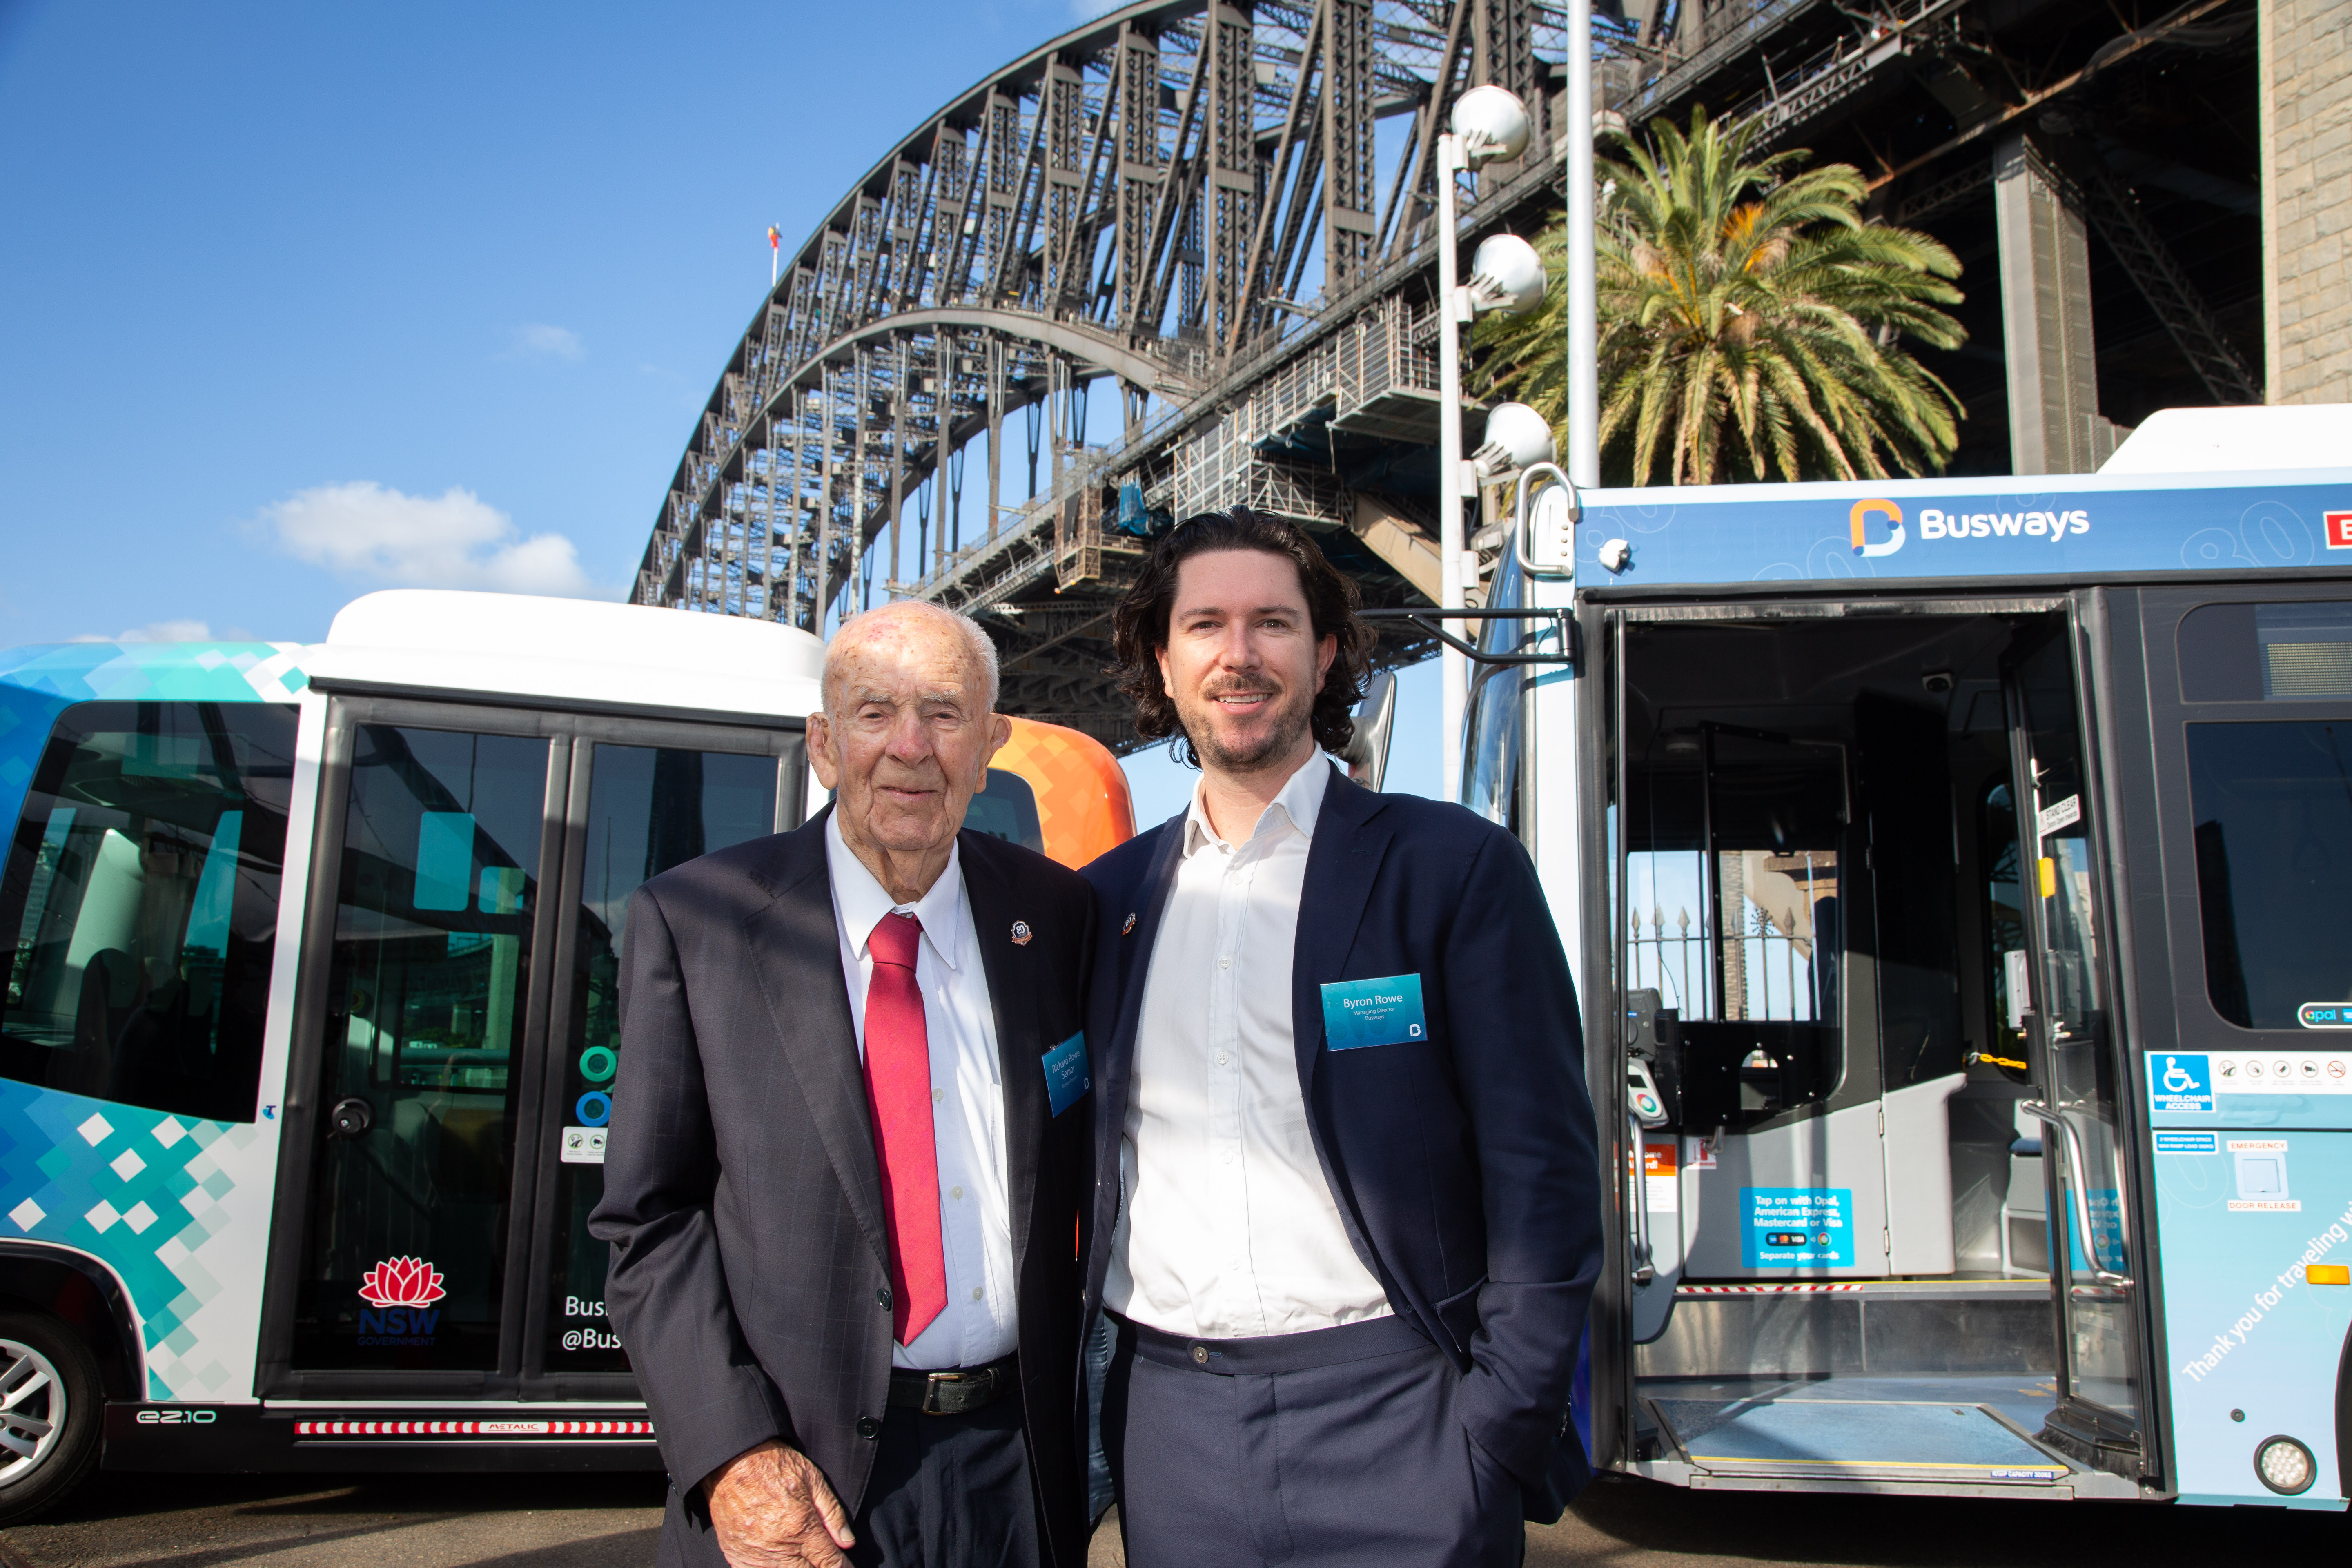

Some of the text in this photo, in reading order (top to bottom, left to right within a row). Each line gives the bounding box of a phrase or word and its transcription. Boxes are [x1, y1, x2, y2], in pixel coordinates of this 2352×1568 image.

[1920, 509, 2090, 543] Busways
[2046, 797, 2076, 820] STAND CLEAR
[1016, 925, 1025, 934] 80
[1343, 994, 1403, 1010] Byron Rowe
[1052, 1050, 1080, 1074] Richard Rowe
[1061, 1065, 1075, 1079] Senior
[1755, 1196, 1773, 1207] Tap
[1790, 1195, 1812, 1205] with
[1814, 1195, 1840, 1207] Opal,
[1754, 1207, 1840, 1218] American Express,
[1754, 1217, 1808, 1227] Mastercard
[1822, 1217, 1843, 1227] Visa
[1760, 1250, 1840, 1261] Separate your cards
[2181, 1335, 2236, 1382] Thank
[2229, 1307, 2263, 1344] you
[2254, 1284, 2283, 1311] for
[2277, 1223, 2348, 1288] traveling
[359, 1308, 440, 1334] NSW
[357, 1336, 436, 1346] GOVERNMENT
